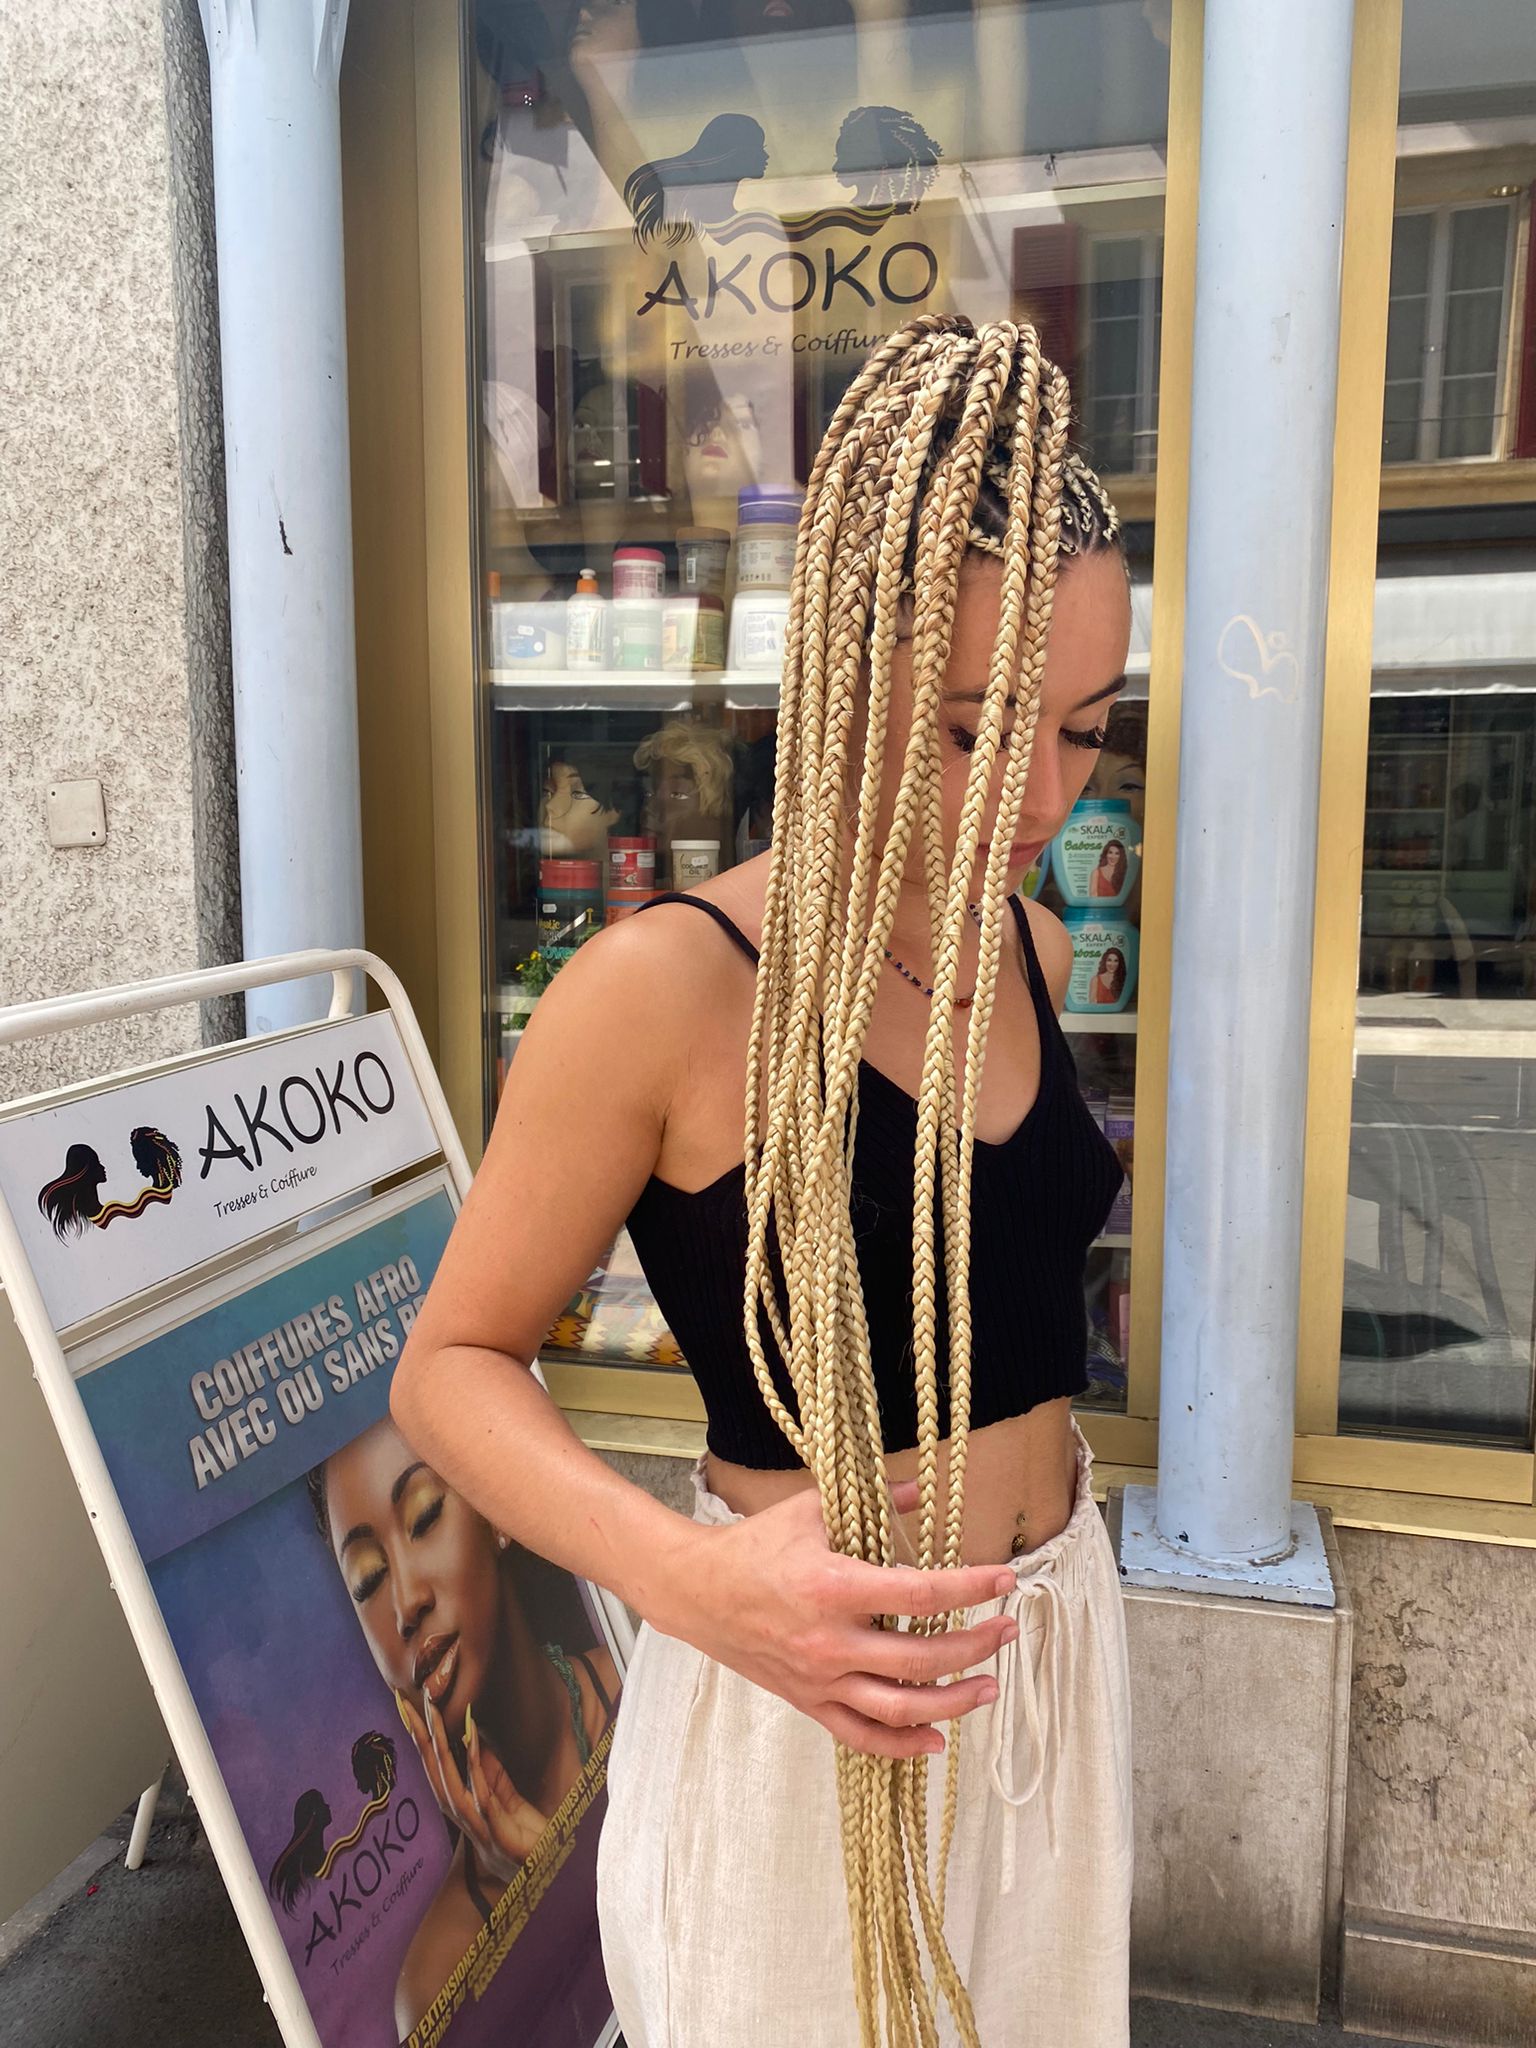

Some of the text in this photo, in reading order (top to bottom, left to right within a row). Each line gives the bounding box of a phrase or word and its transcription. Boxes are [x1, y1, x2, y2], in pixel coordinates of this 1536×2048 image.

[636, 241, 938, 320] AKOKO
[670, 338, 756, 360] Tresses
[762, 336, 782, 356] &
[1064, 840, 1103, 851] Babosa
[1080, 825, 1113, 835] SKALA
[1079, 933, 1112, 943] SKALA
[199, 1051, 395, 1179] AKOKO
[213, 1166, 318, 1218] Tresses & Coiffure
[191, 1295, 353, 1421] COIFFURES
[354, 1254, 421, 1323] AFRO
[188, 1318, 400, 1490] AVEC OU SANS
[305, 1797, 420, 1967] AKOKO
[330, 1927, 370, 1976] Tresses
[382, 1857, 424, 1912] Coiffure
[408, 1943, 478, 2048] D'EXTENSIONS
[476, 1922, 490, 1950] DE
[489, 1866, 527, 1931] CHEVEUX
[576, 1773, 588, 1795] ET
